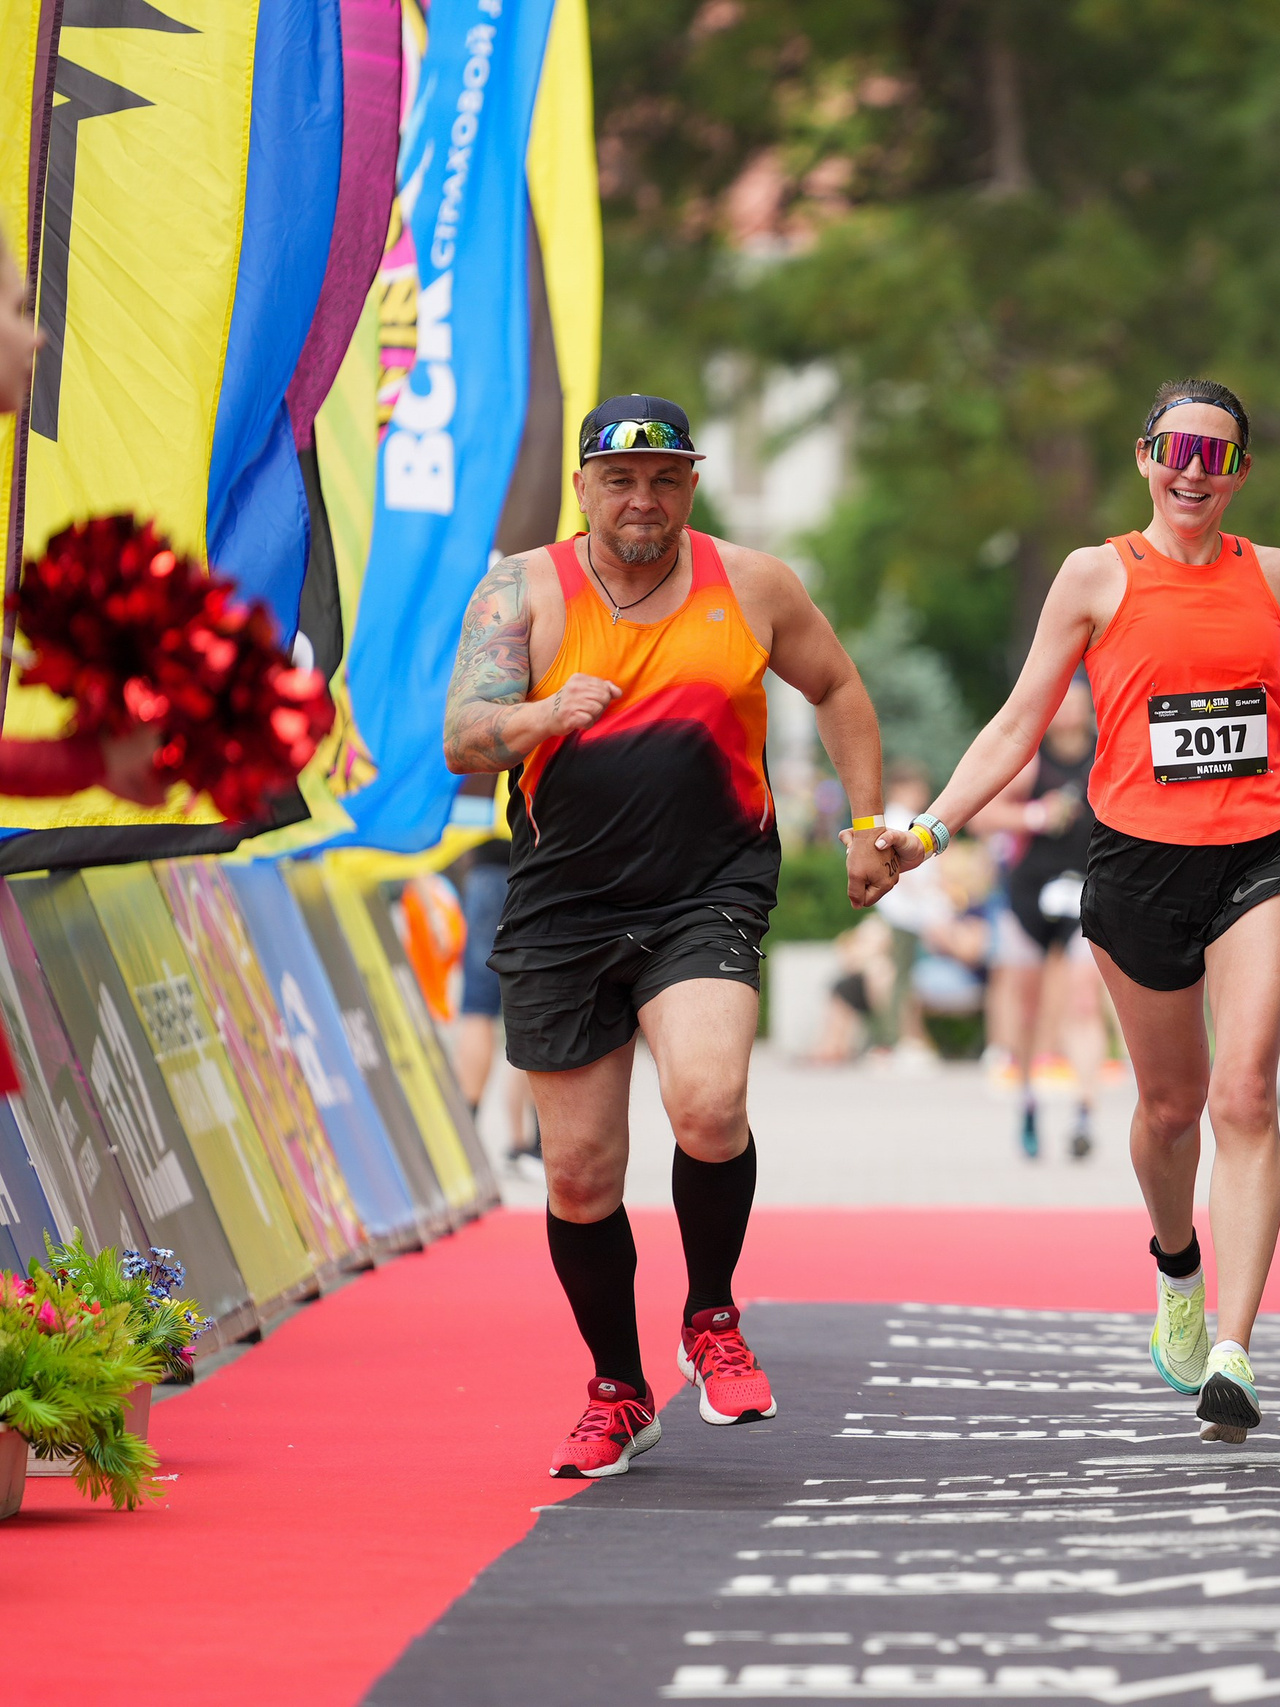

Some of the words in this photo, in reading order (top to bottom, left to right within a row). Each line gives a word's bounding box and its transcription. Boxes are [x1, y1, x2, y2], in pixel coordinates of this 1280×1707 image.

[1190, 698, 1207, 709] IRON
[1212, 697, 1230, 706] STAR
[1174, 723, 1248, 759] 2017
[1196, 763, 1233, 775] NATALYA
